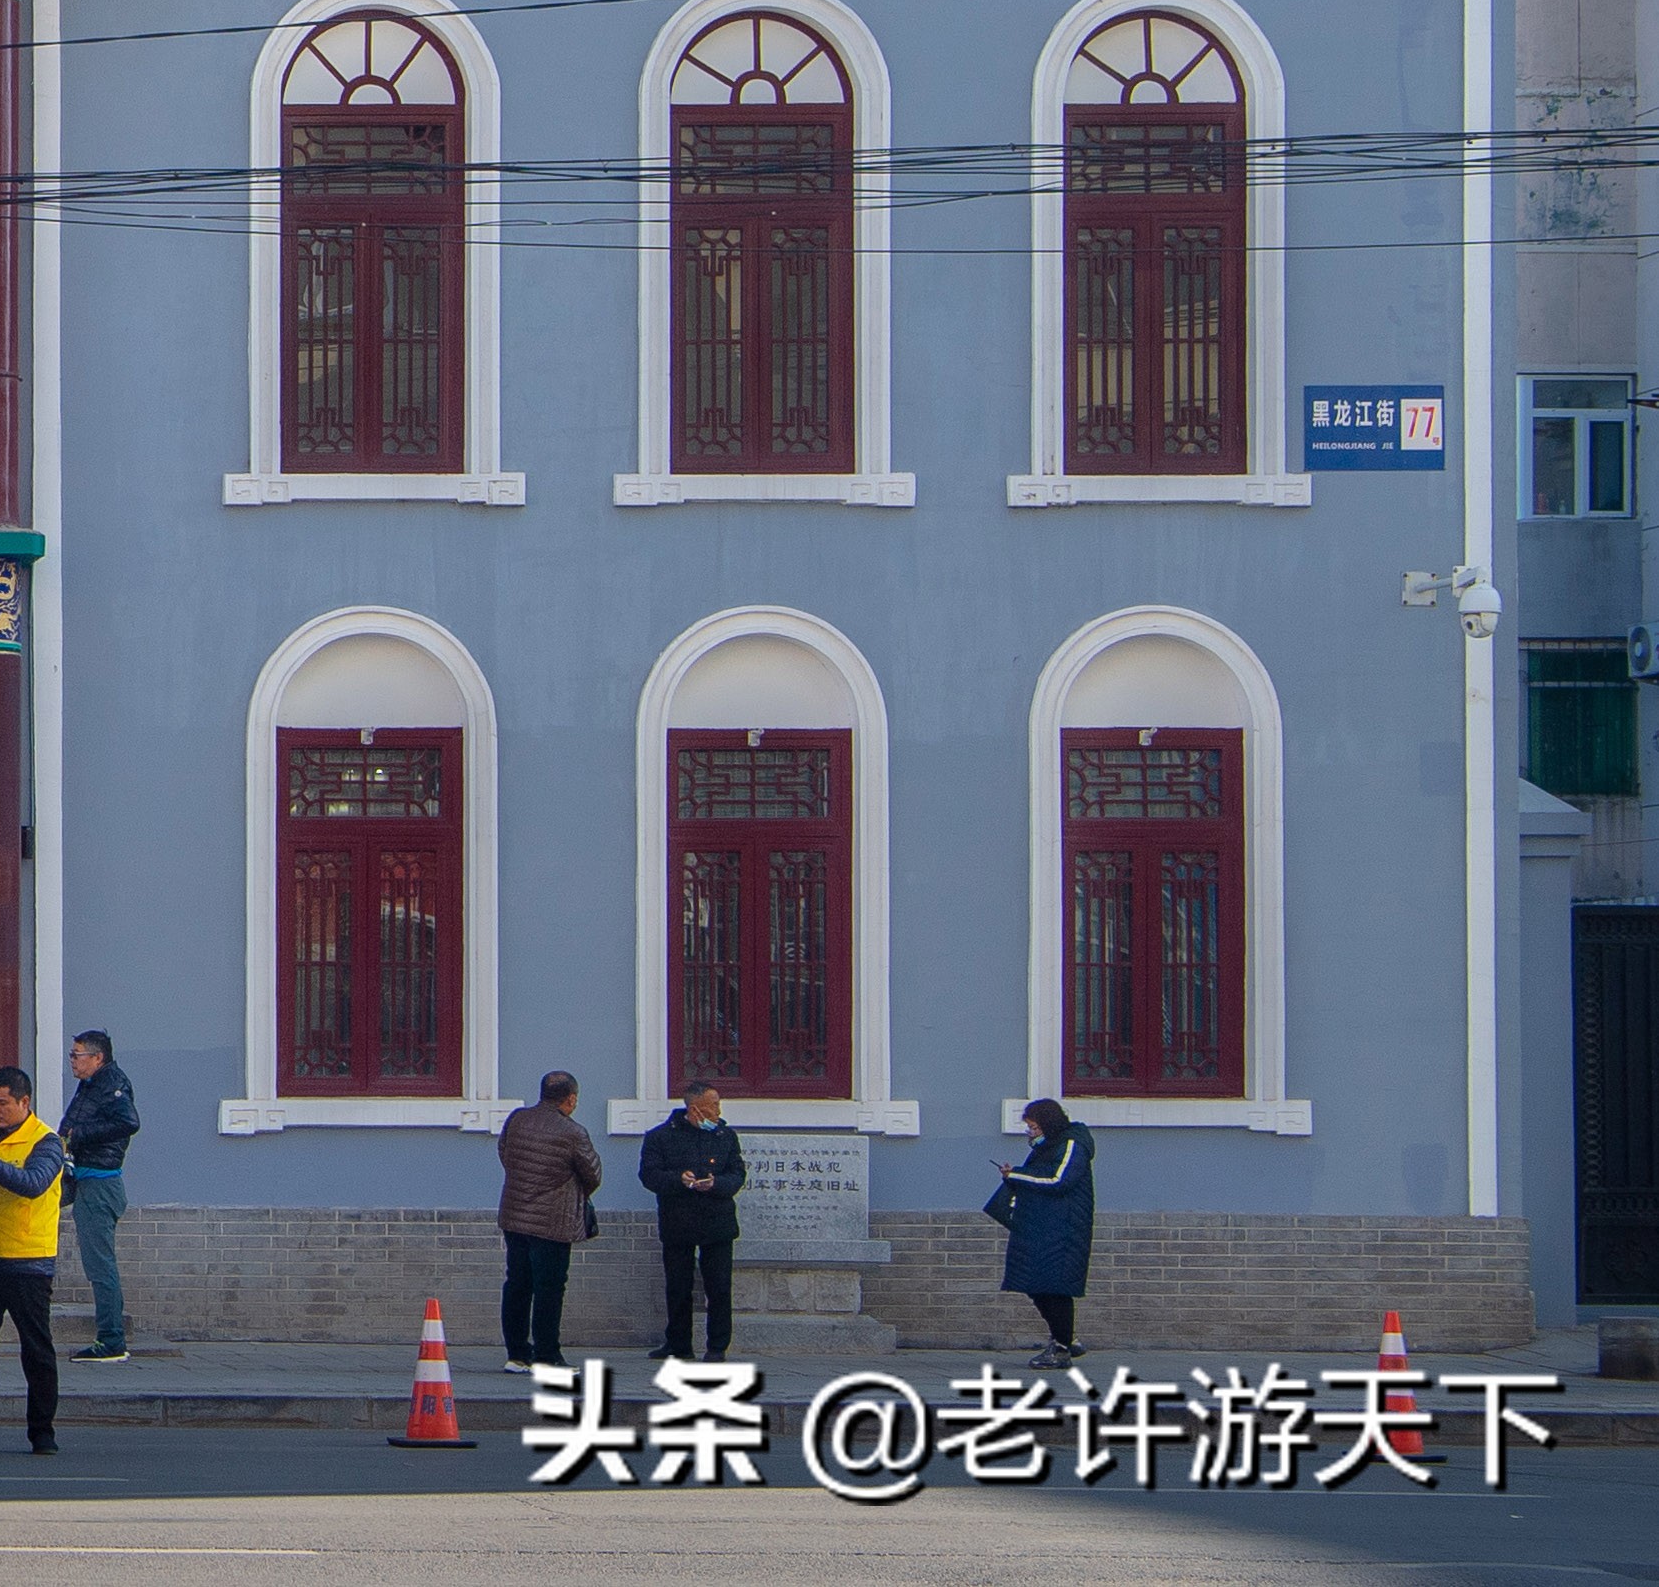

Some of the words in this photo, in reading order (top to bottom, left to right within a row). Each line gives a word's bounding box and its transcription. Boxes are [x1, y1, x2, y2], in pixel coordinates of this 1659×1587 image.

[1311, 399, 1395, 428] 黑龙江街
[1311, 441, 1377, 450] HEILONGJIANG
[1381, 441, 1394, 450] JIE
